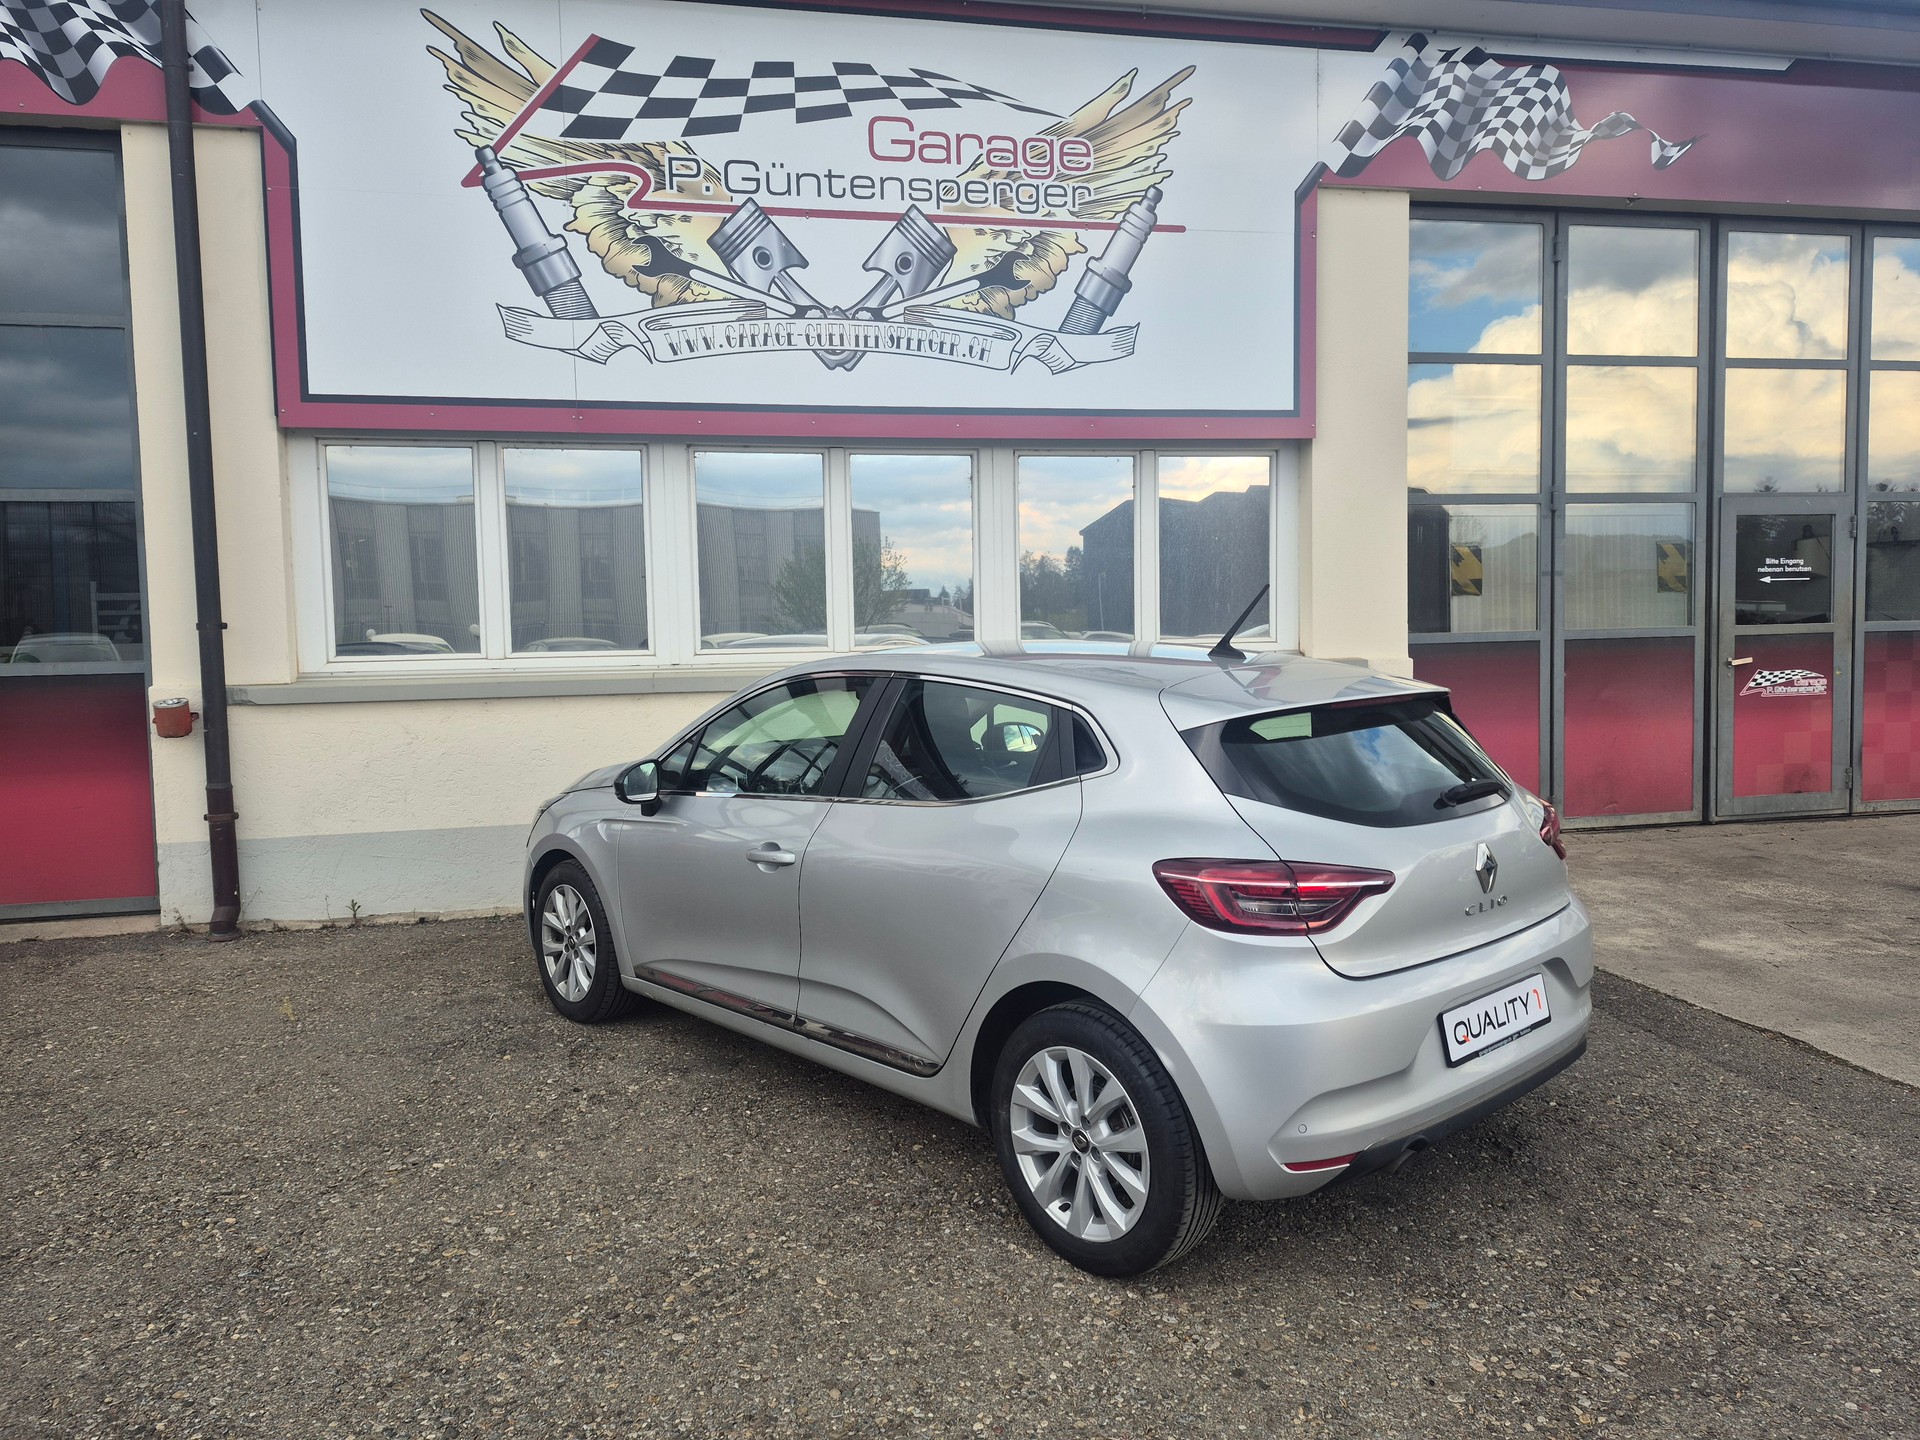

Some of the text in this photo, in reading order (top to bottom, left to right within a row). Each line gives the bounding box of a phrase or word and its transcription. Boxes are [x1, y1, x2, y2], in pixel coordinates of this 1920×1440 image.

[868, 115, 1092, 180] Garage
[667, 156, 1092, 210] P. Güntensperger
[664, 322, 994, 363] WWW.GARAGE-GUENTENSPERGER.CH
[1765, 557, 1804, 566] Bitte Eingang
[1465, 894, 1508, 917] CLIO
